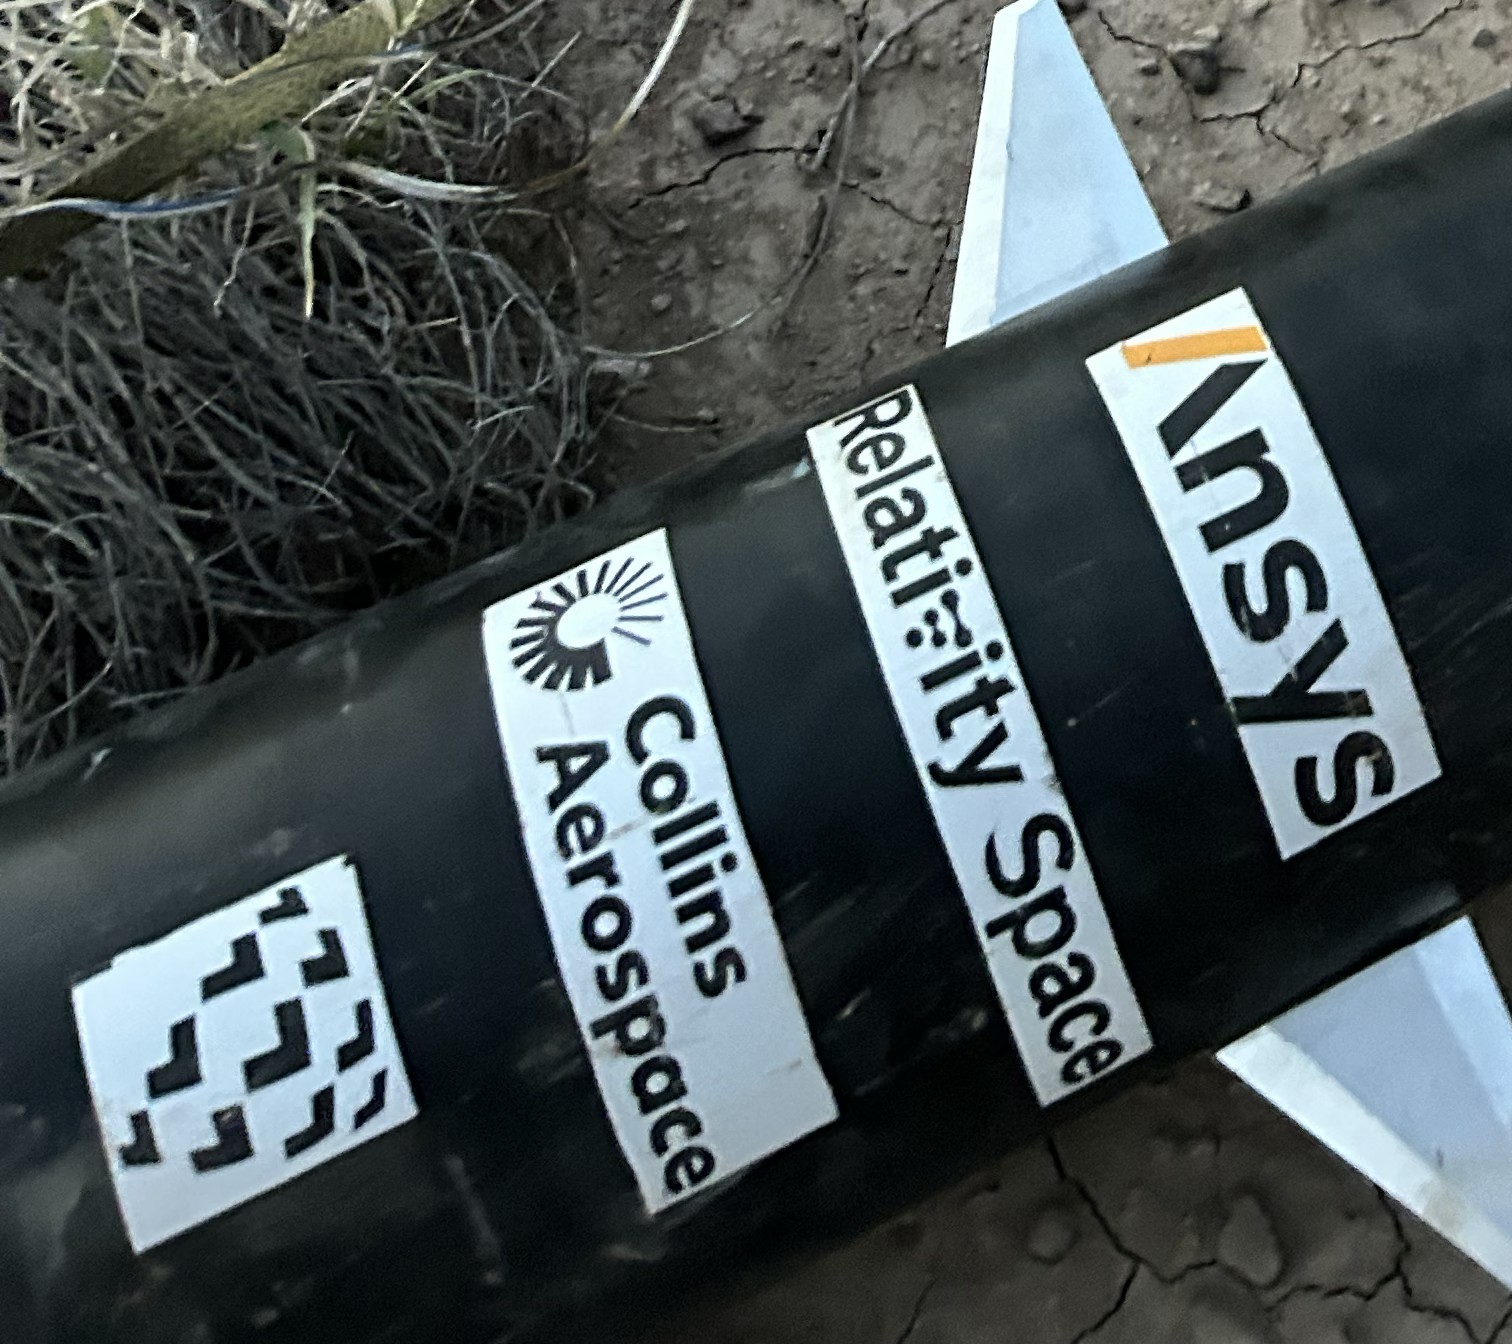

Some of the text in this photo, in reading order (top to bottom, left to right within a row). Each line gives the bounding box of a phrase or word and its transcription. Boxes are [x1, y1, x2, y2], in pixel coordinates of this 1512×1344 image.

[1121, 326, 1396, 826] Ansys
[534, 740, 715, 1196] Aerospace
[624, 695, 747, 1000] Collins
[984, 812, 1125, 1086] Space
